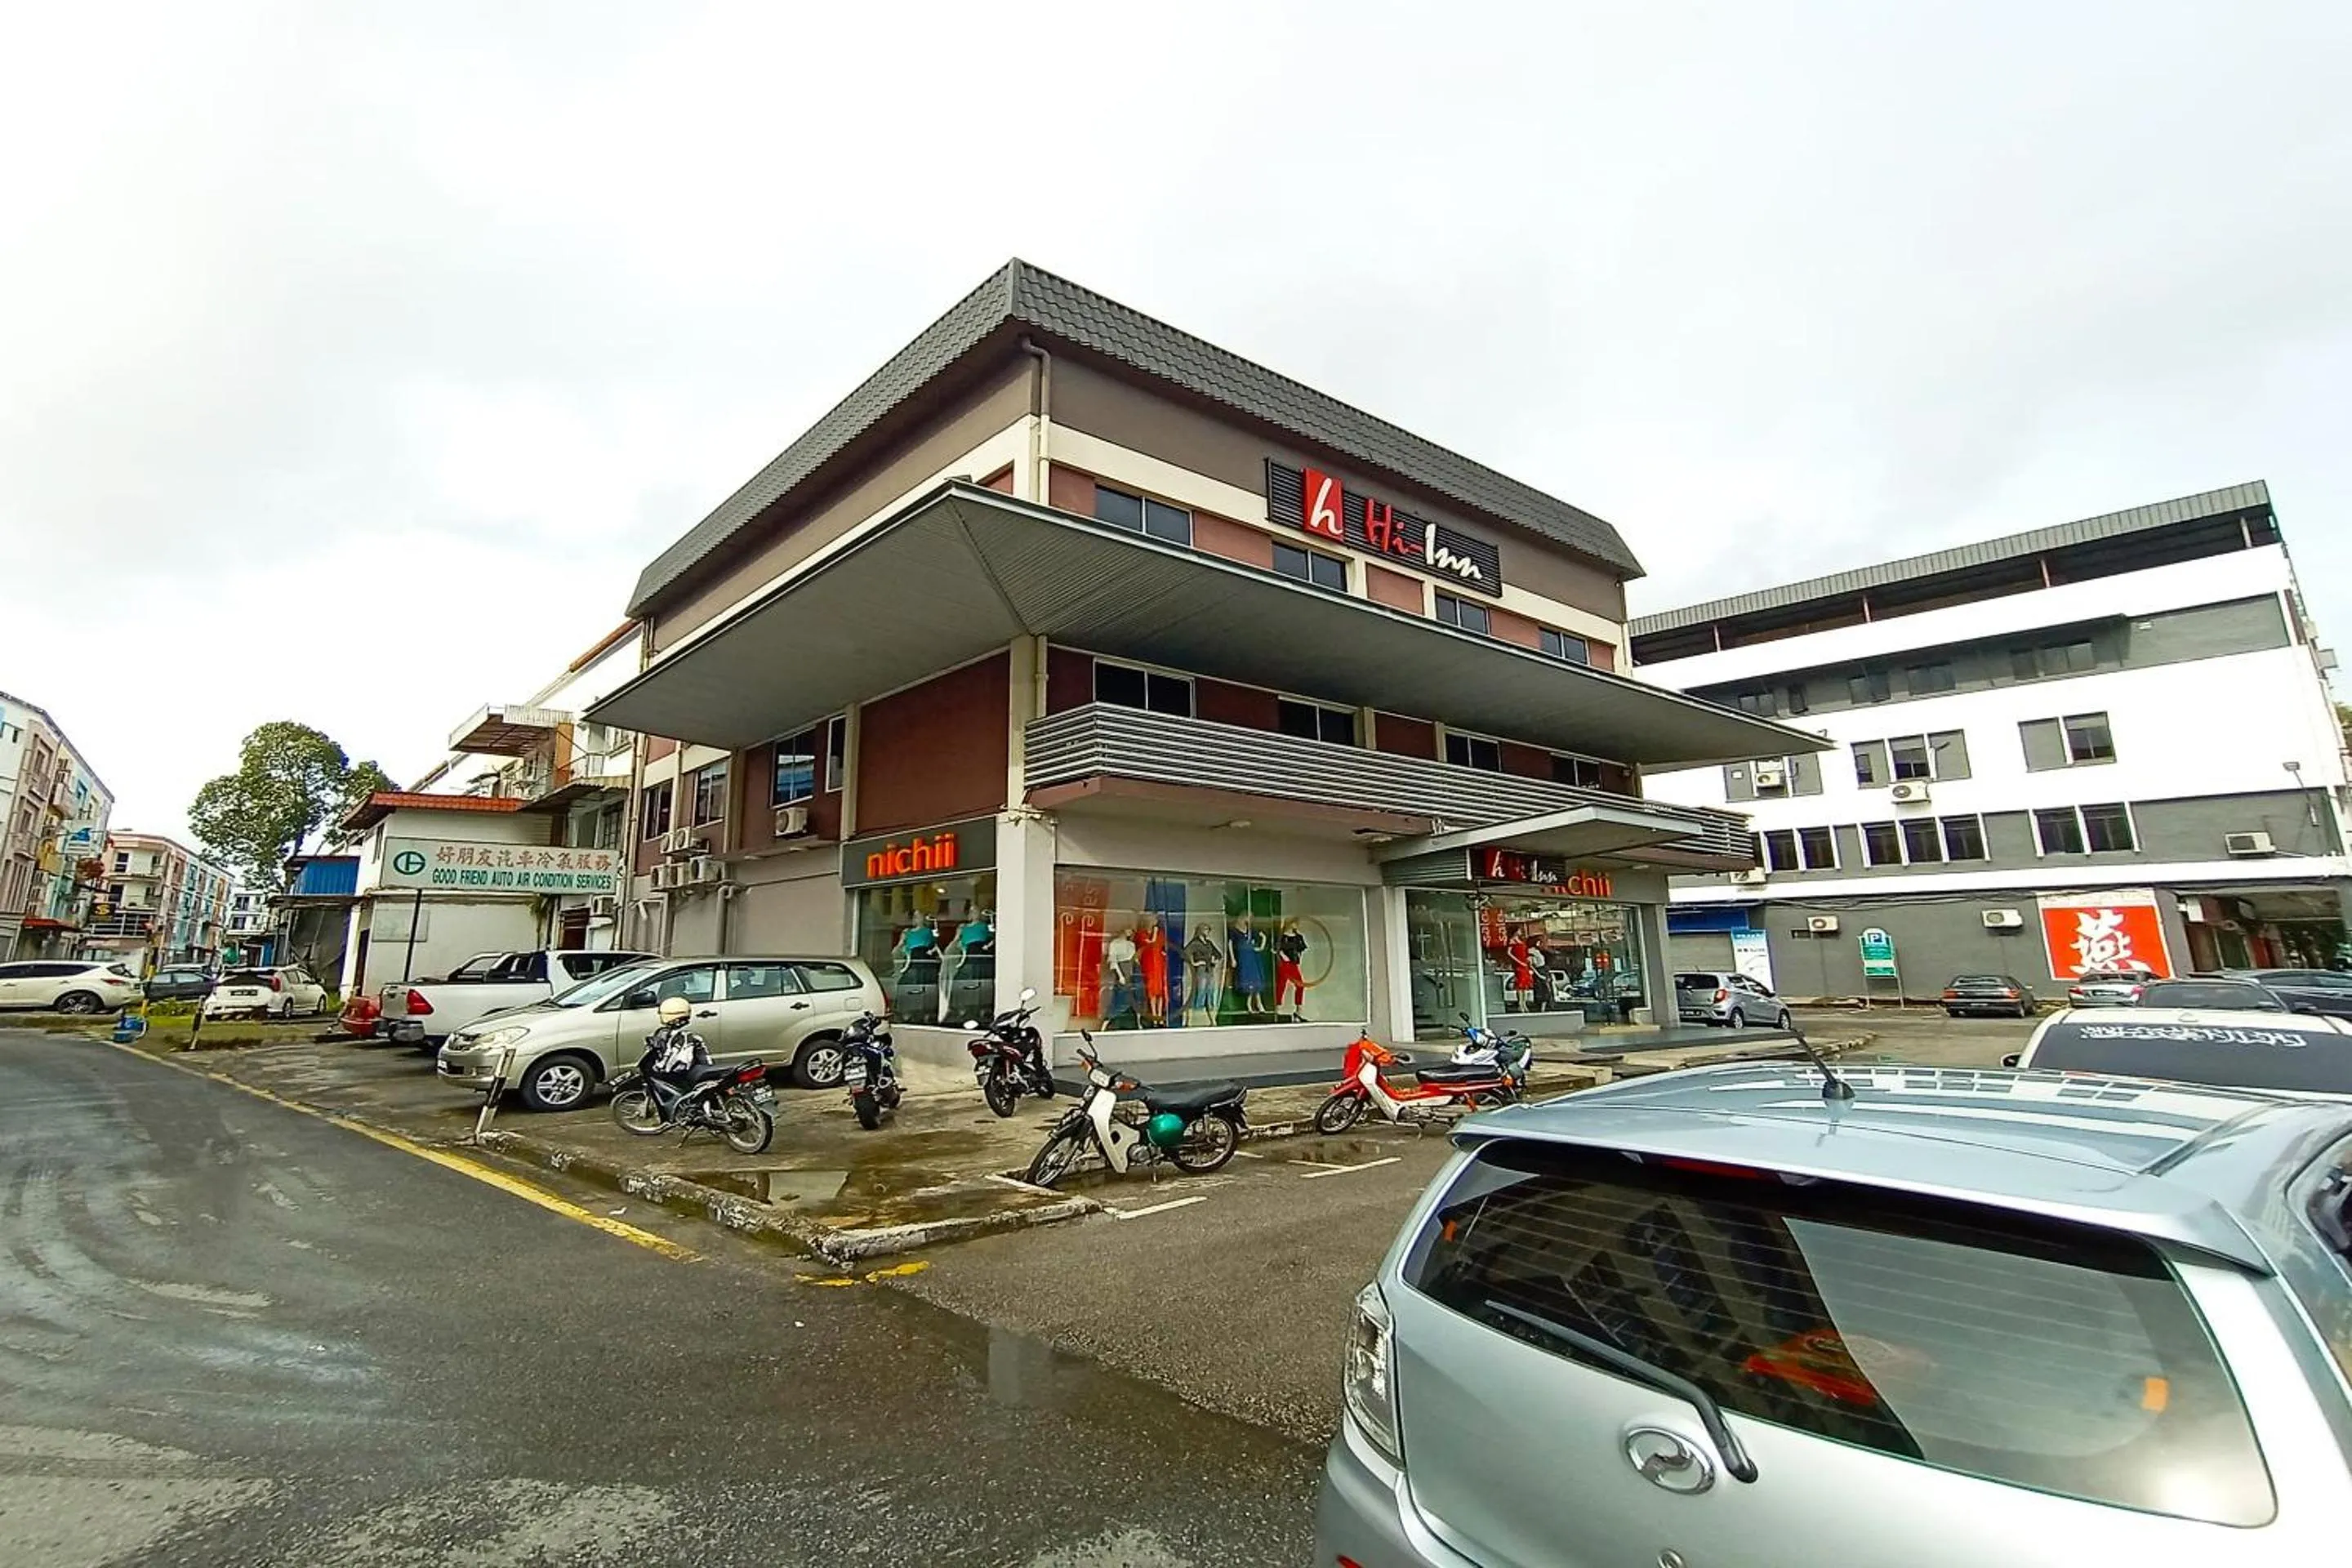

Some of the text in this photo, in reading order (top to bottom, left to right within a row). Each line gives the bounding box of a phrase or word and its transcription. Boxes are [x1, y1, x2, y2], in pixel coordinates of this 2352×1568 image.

[866, 833, 956, 879] nichii
[432, 868, 612, 890] GOOD FRIEND AUTO AIR CONDITION SERVICES
